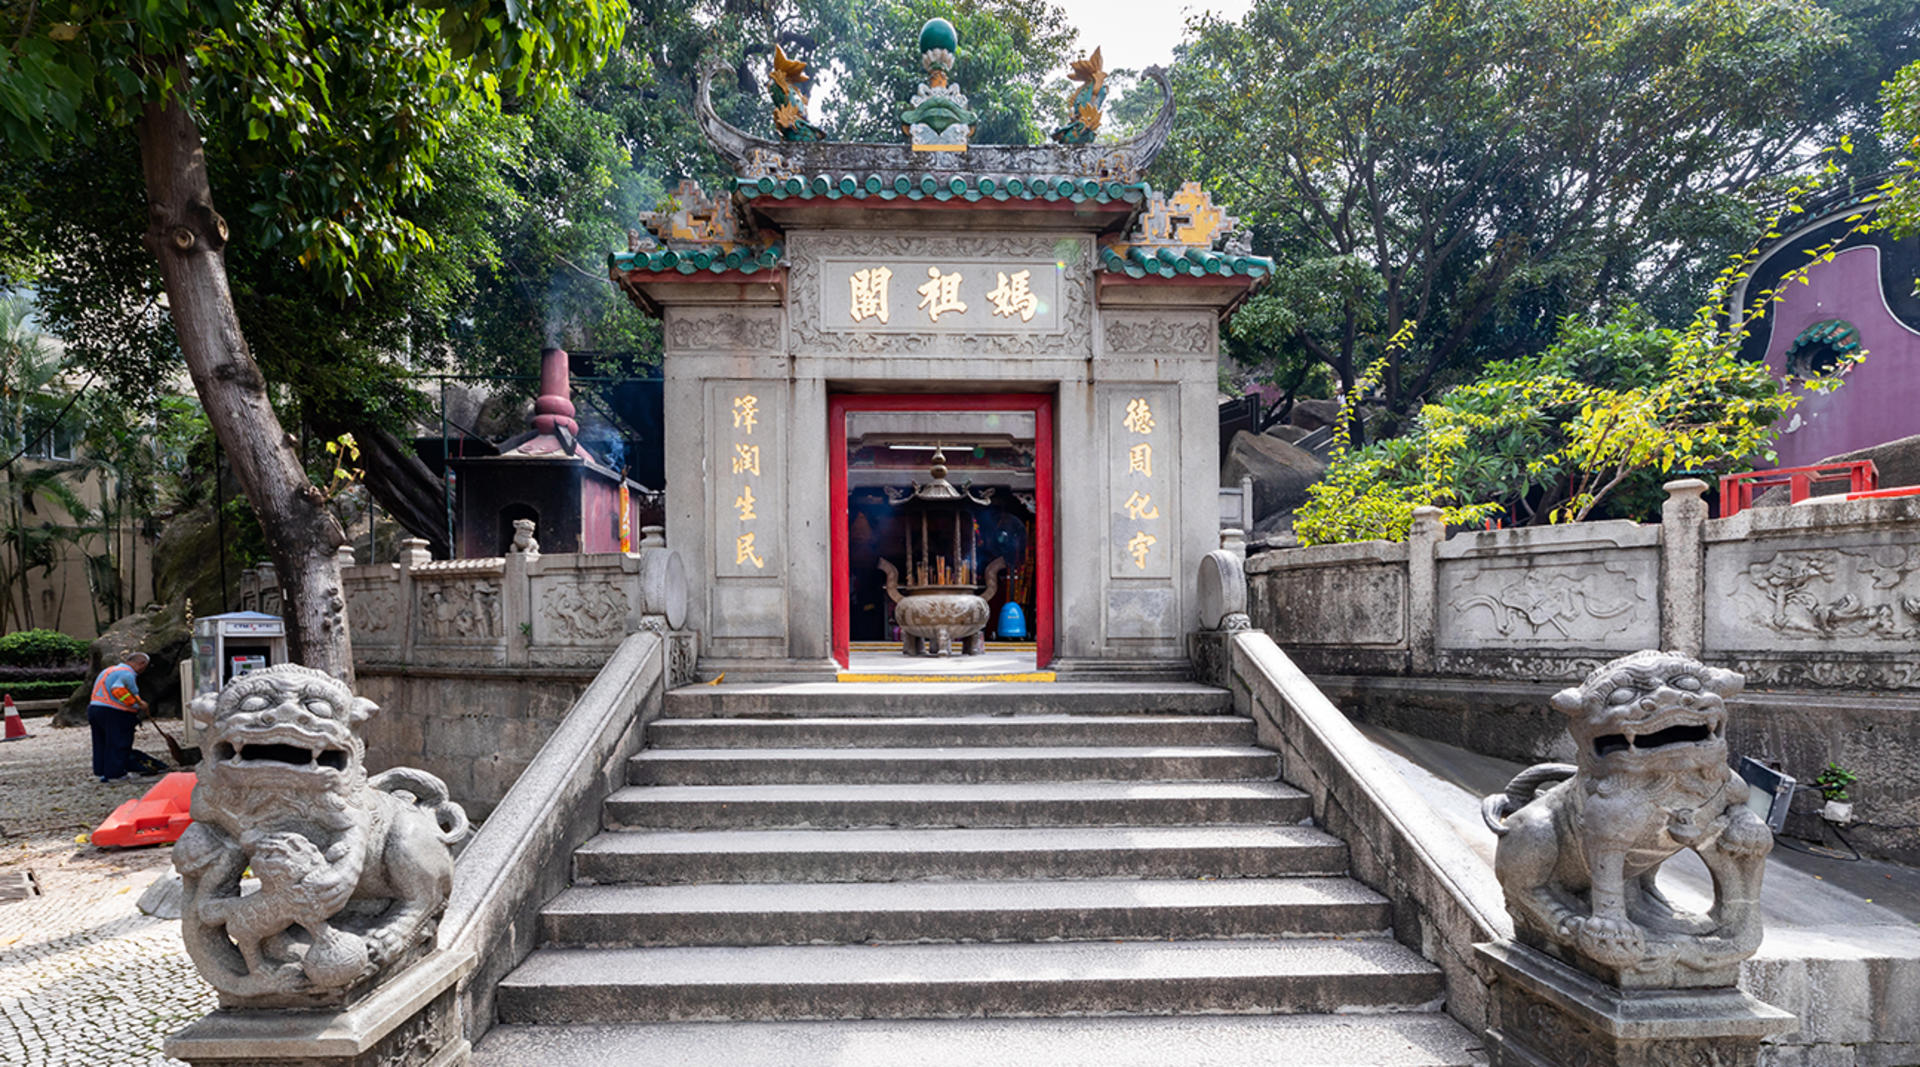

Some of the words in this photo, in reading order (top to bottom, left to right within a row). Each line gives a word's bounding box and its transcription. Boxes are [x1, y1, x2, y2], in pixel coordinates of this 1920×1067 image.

[732, 394, 764, 569] 澤潤生民
[1123, 397, 1160, 570] 德周化宇
